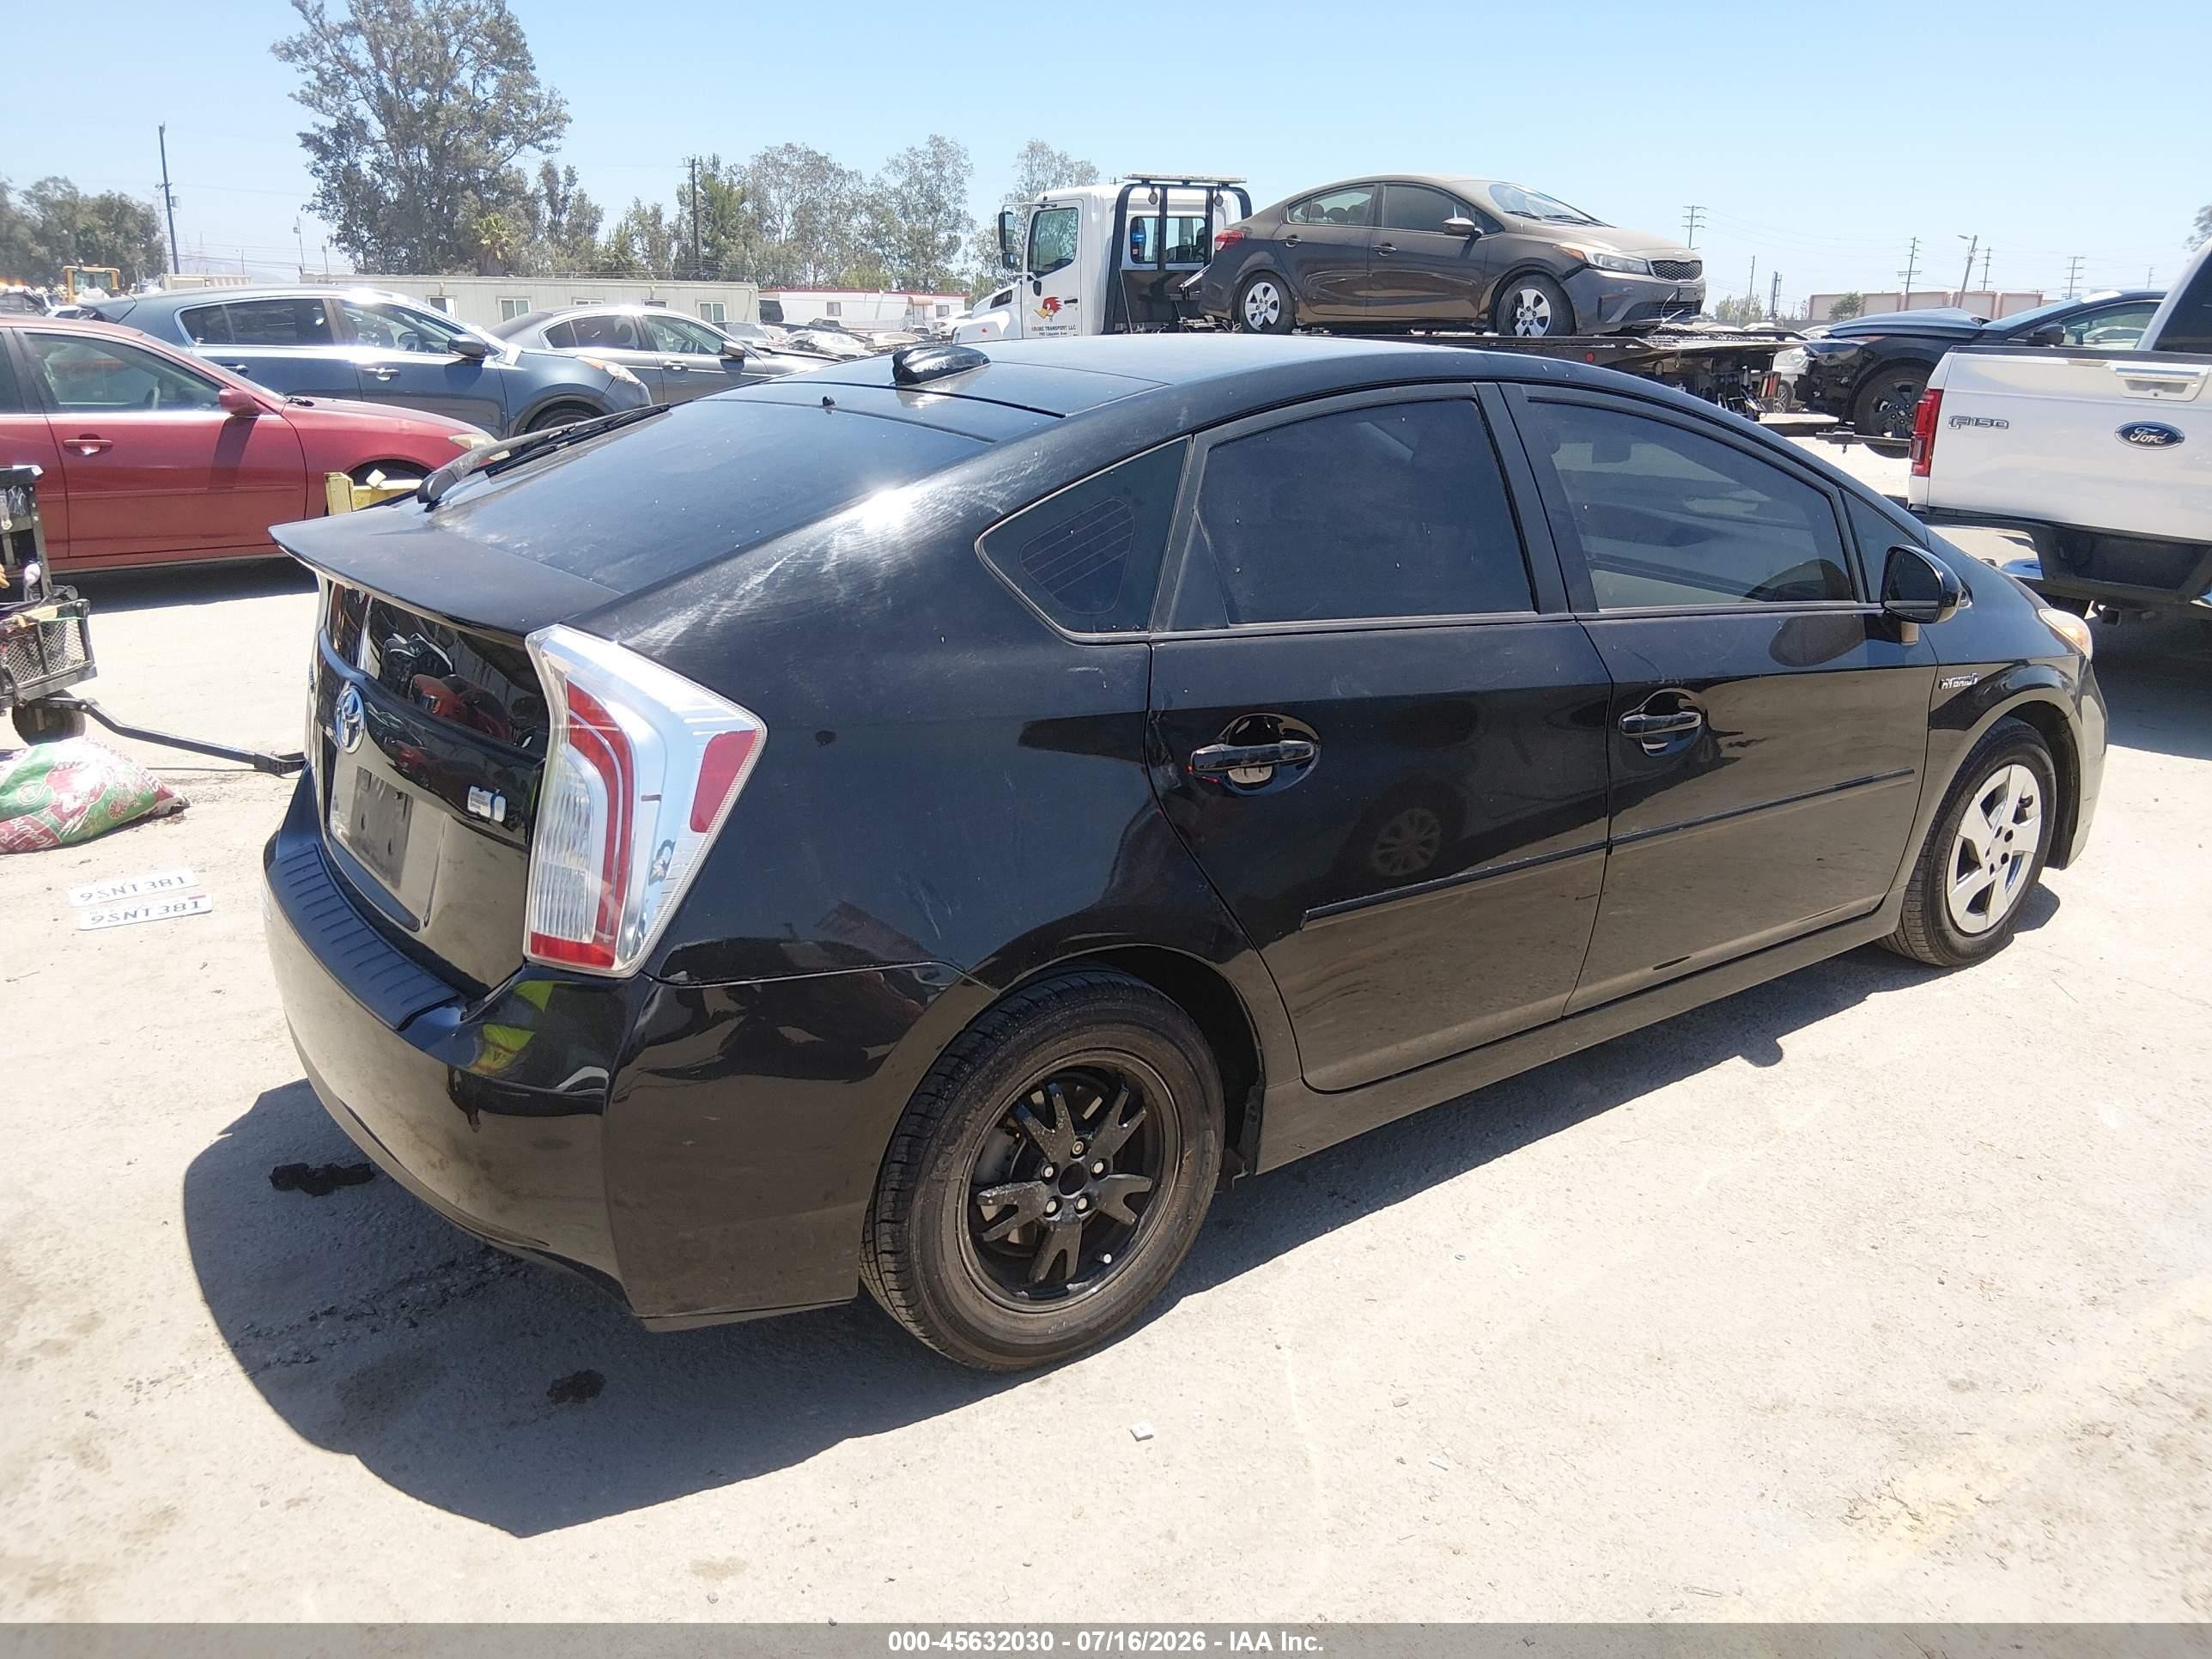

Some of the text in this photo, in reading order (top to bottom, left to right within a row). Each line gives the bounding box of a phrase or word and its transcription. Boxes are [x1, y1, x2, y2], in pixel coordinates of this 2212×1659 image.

[2130, 426, 2169, 445] Ford
[80, 876, 186, 902] 9SNT381
[91, 900, 203, 925] 9SNT381
